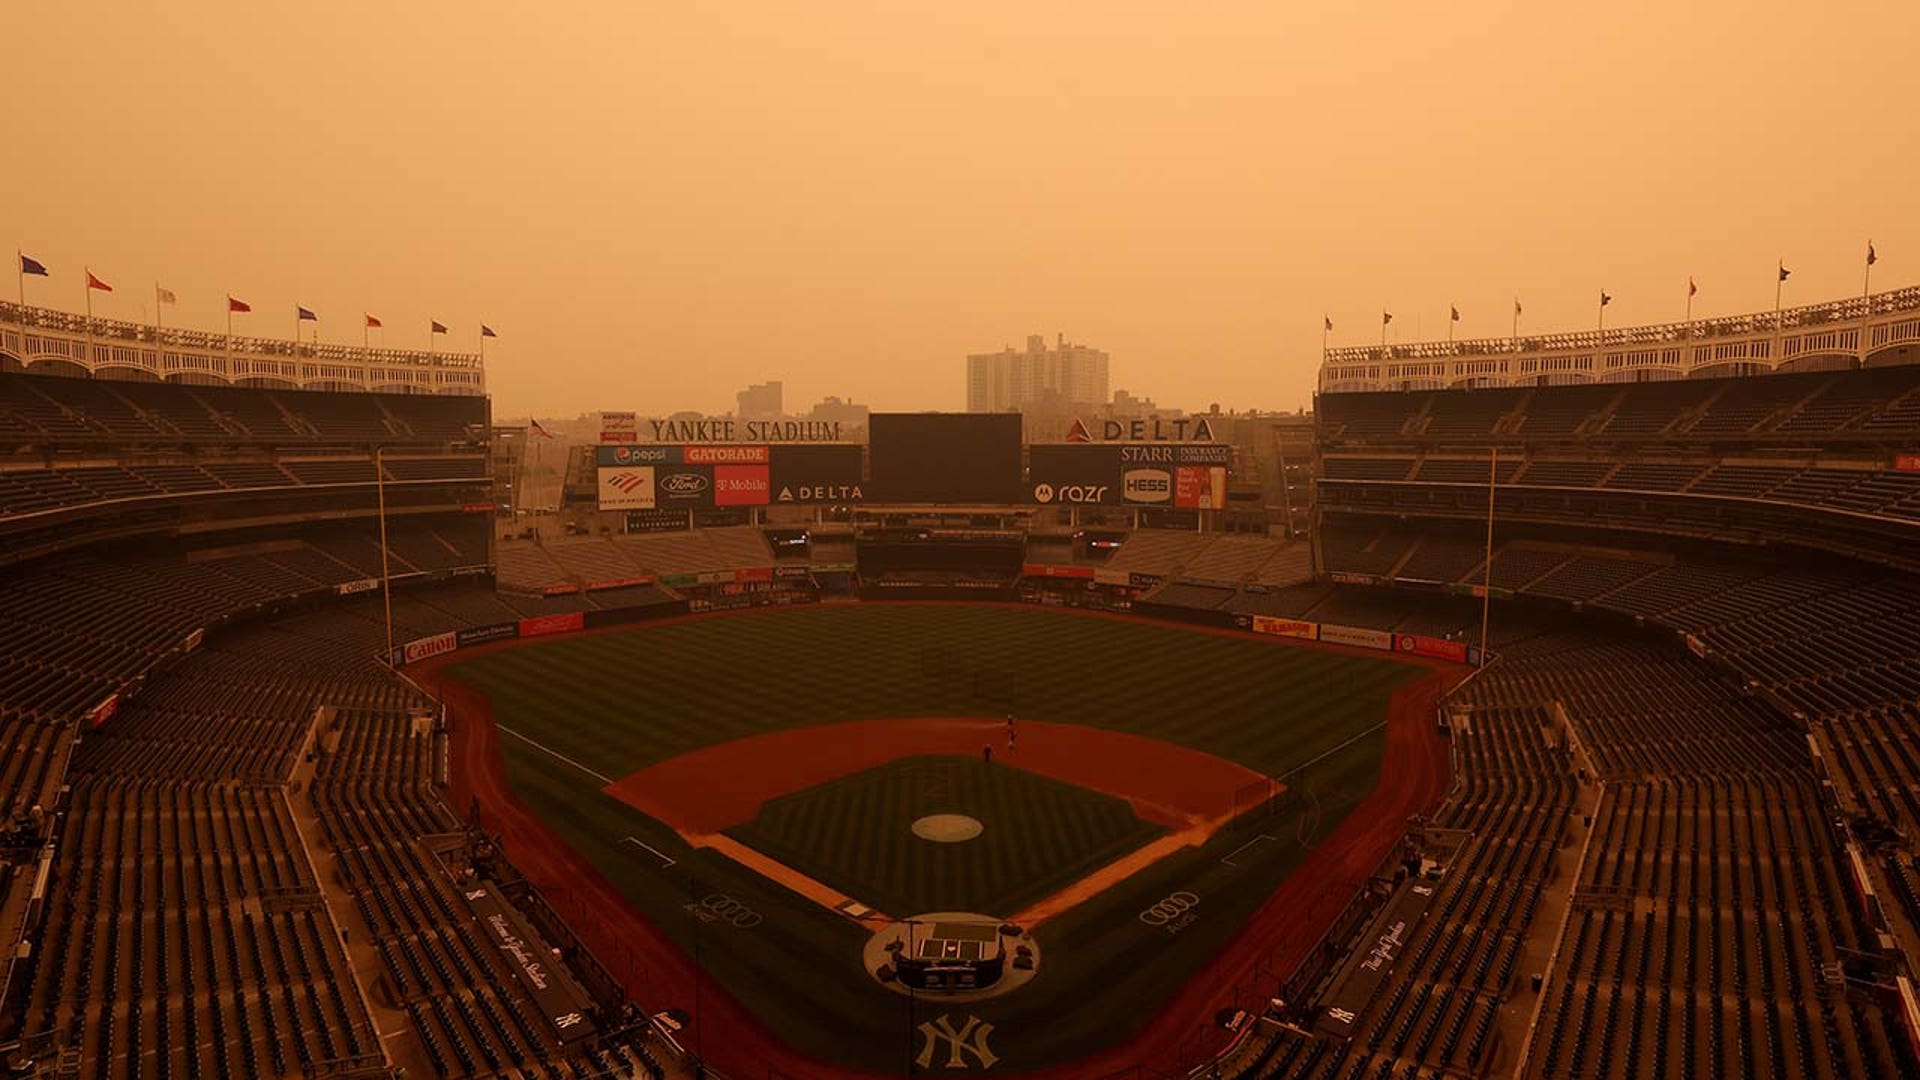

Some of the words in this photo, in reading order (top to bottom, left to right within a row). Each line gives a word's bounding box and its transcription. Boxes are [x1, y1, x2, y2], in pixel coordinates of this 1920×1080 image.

[651, 420, 735, 442] YANKEE
[747, 420, 840, 442] STADIUM
[1104, 419, 1215, 442] DELTA
[632, 448, 666, 463] pepsi
[689, 448, 765, 461] GATORADE
[1121, 446, 1174, 463] STARR
[669, 476, 701, 491] Ford
[729, 479, 767, 491] Mobile
[1126, 479, 1169, 492] HESS
[799, 486, 864, 499] DELTA
[1058, 486, 1109, 503] razr
[406, 632, 456, 660] Canon
[914, 1014, 999, 1069] NY
